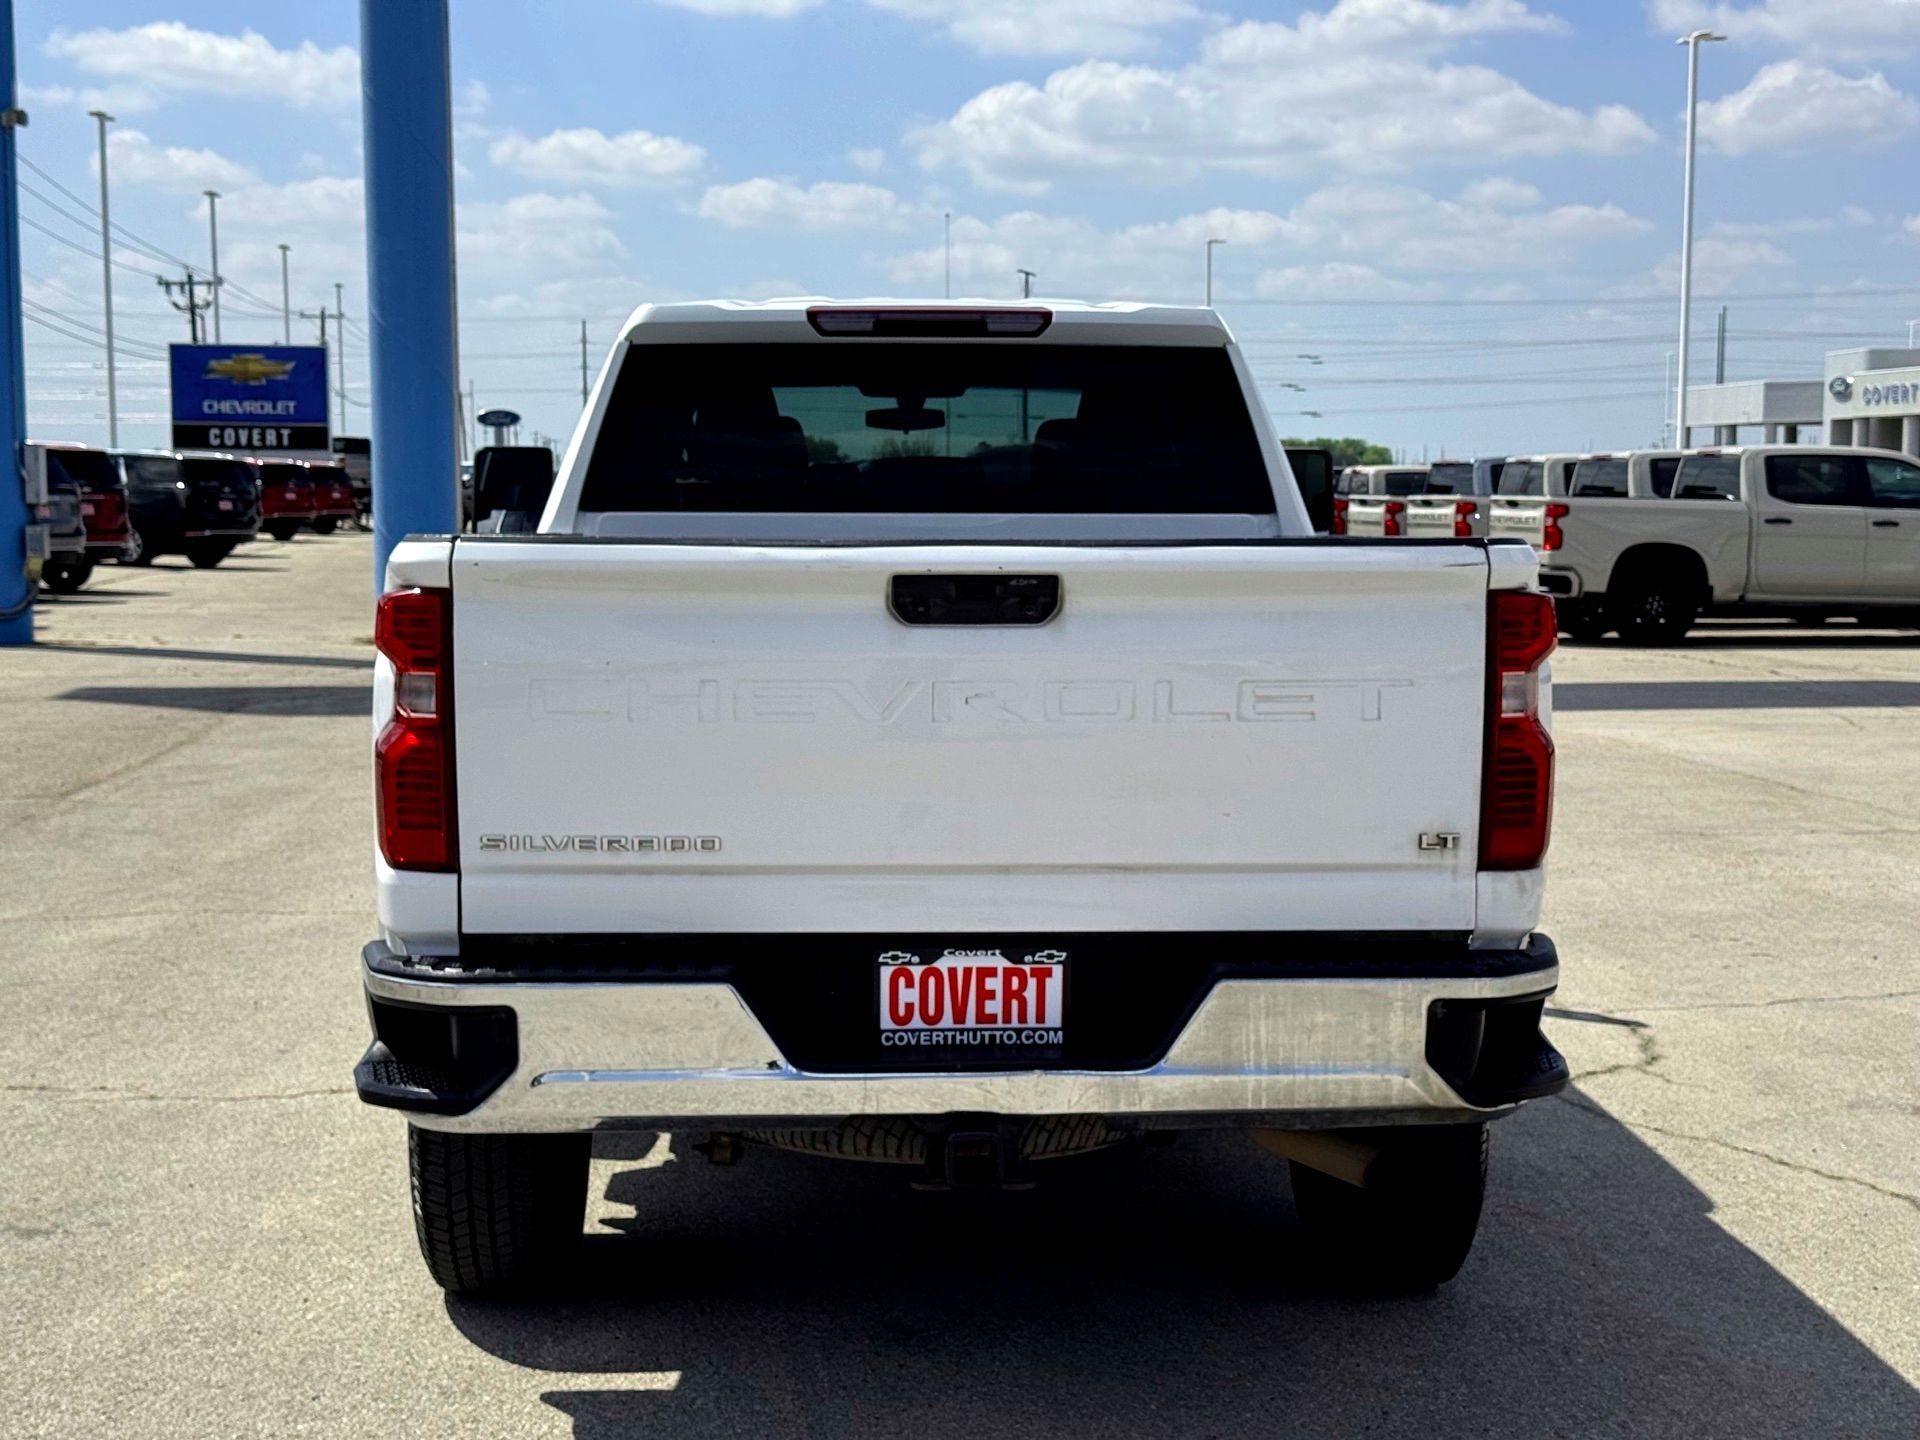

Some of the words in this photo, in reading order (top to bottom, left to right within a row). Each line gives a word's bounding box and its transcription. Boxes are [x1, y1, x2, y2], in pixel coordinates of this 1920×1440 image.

[1862, 383, 1919, 405] COVERT
[202, 399, 297, 415] CHEVROLET
[208, 427, 291, 447] COVERT
[528, 678, 1414, 723] CHEVROLET
[479, 834, 723, 852] SILVERADO
[1418, 832, 1460, 850] LT
[943, 949, 1002, 957] Covert
[889, 966, 1054, 1026] COVERT
[881, 1031, 1063, 1046] COVERTHUTTO.COM
